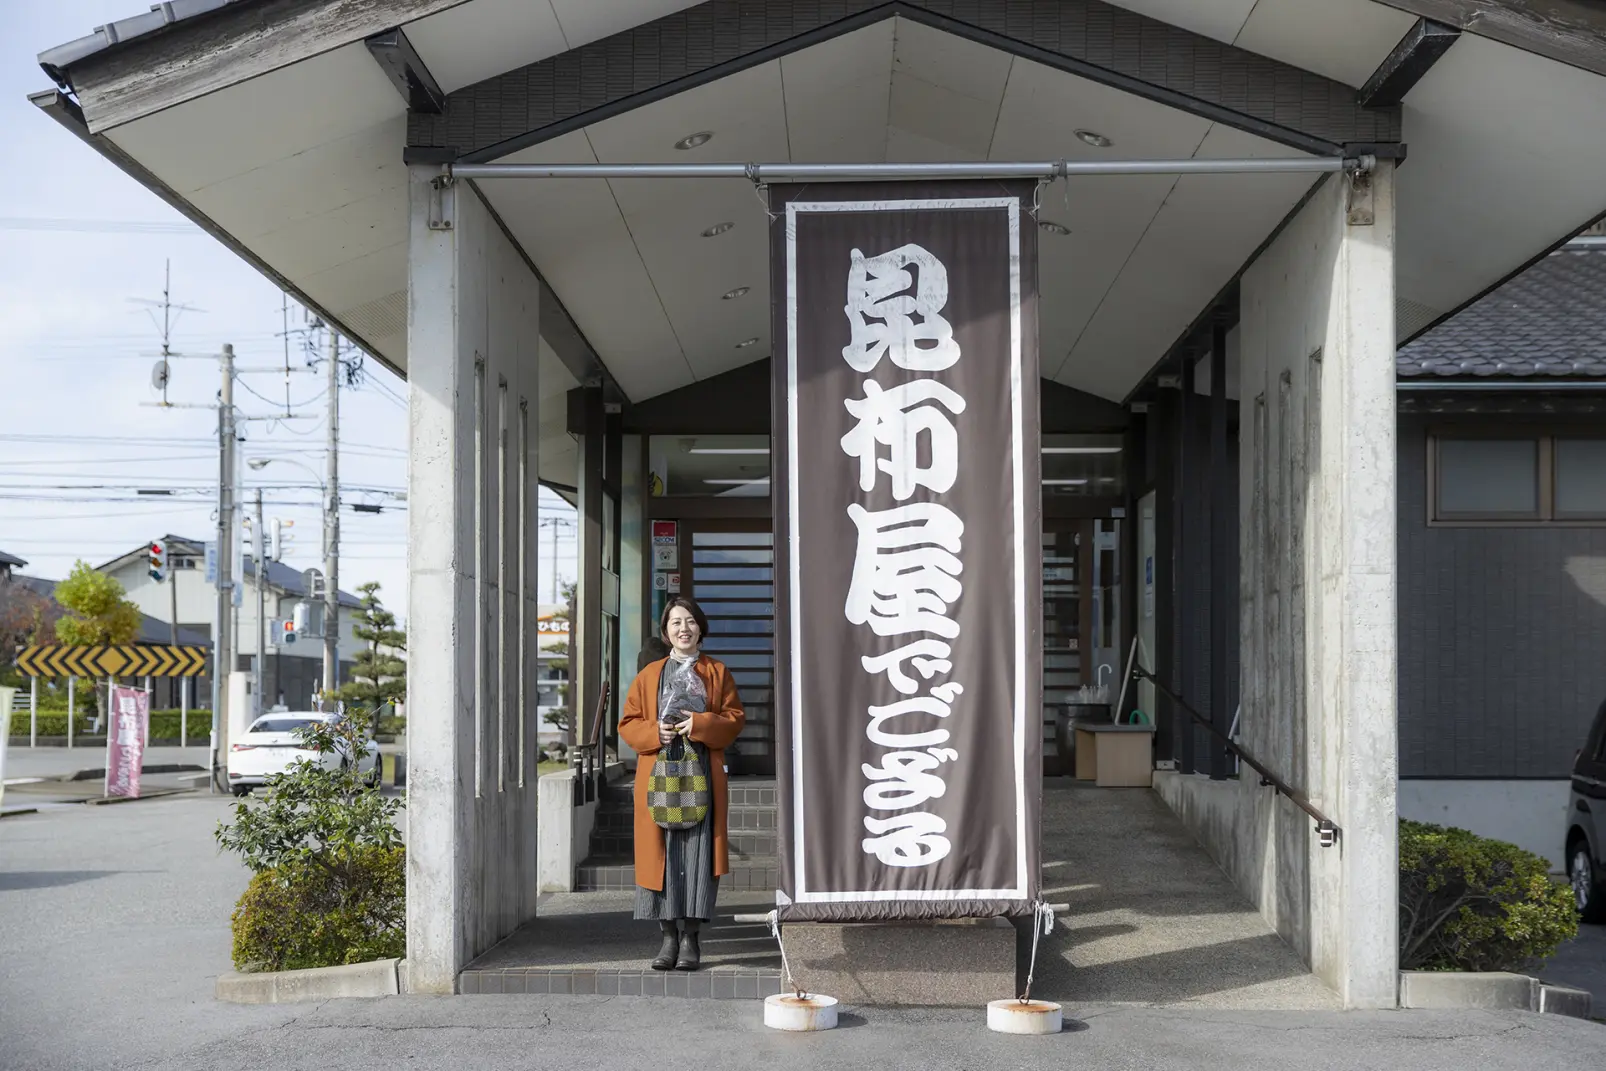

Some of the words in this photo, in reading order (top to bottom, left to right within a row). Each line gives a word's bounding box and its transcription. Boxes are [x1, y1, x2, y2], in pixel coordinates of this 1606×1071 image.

[840, 243, 966, 868] 昆布屋でござる
